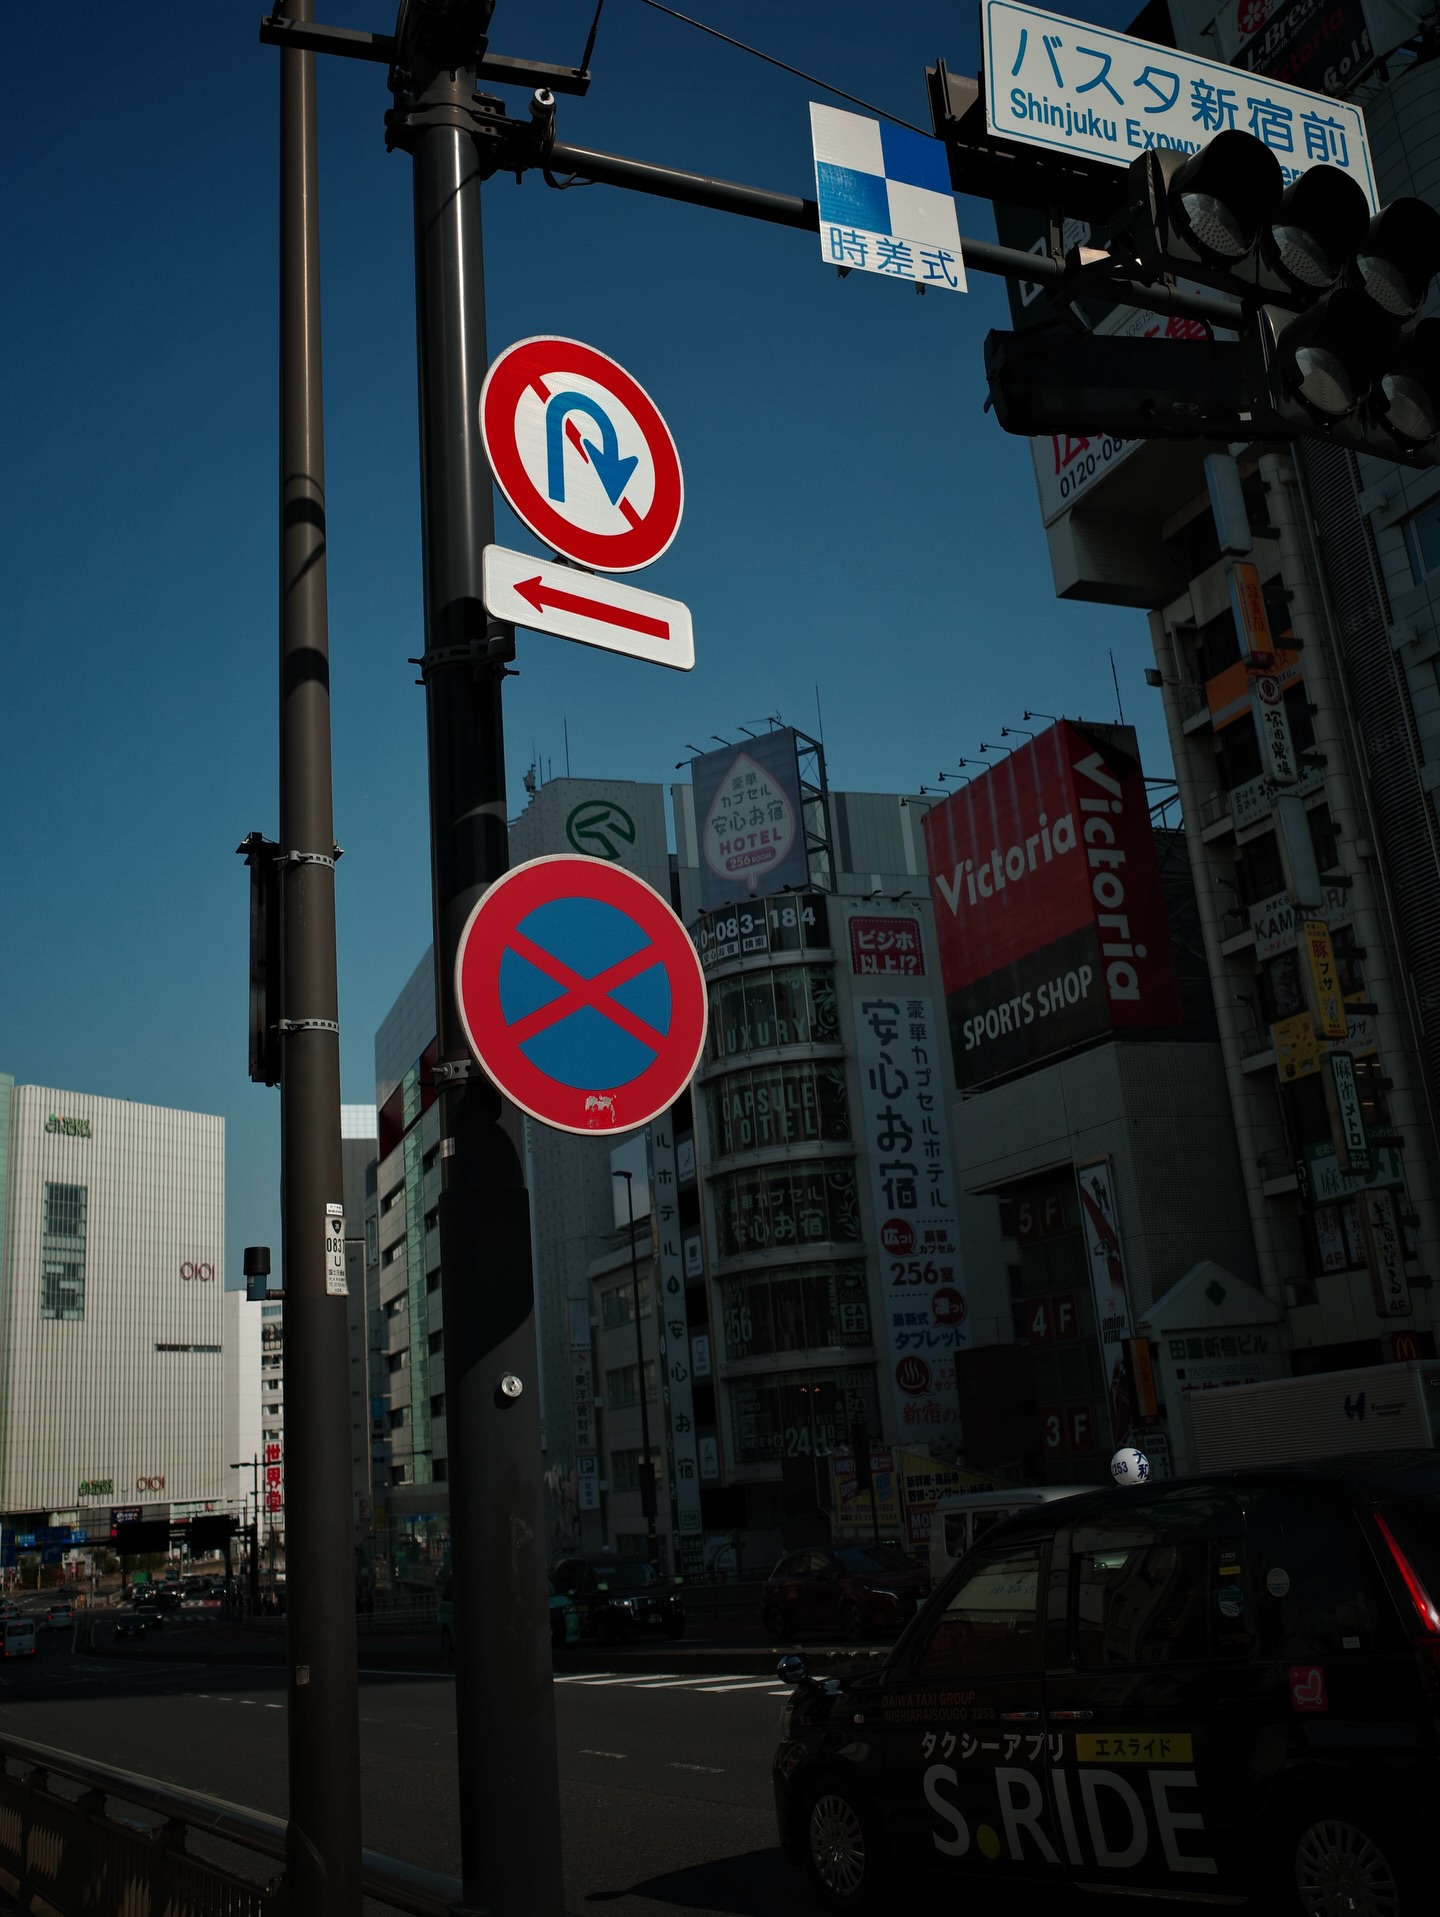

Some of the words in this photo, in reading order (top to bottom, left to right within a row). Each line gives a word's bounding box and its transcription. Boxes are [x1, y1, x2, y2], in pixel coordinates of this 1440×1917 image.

[1011, 29, 1349, 167] バスタ新宿前
[1011, 88, 1117, 142] Shinjuku
[829, 226, 958, 287] 時差式
[720, 784, 772, 808] カプセル
[711, 800, 784, 837] 安心お宿
[719, 827, 782, 856] HOTEL
[730, 858, 751, 869] 256
[751, 854, 772, 863] ROOM
[935, 811, 1077, 918] Victoria
[1072, 751, 1149, 1001] Victoria
[857, 929, 916, 950] ビジホ
[963, 992, 1034, 1051] SPORTS
[1039, 964, 1093, 1018] SHOP
[722, 1083, 815, 1122] CAPSULE
[861, 998, 919, 1211] 安心お宿
[905, 1000, 948, 1208] 豪華カプセルホテル
[1335, 1060, 1363, 1147] 麻雀メトロ
[724, 1111, 818, 1150] HOTEL
[1018, 1196, 1058, 1234] 5F
[894, 1328, 967, 1350] タブレット
[1032, 1303, 1072, 1338] 4F
[1046, 1413, 1087, 1449] 3F
[266, 1443, 281, 1514] 世界堂
[1133, 1450, 1149, 1480] 大和
[882, 1695, 913, 1708] DAIWA
[916, 1693, 939, 1707] TAXI
[939, 1691, 976, 1706] GROUP
[972, 1707, 995, 1720] 2253
[921, 1731, 1065, 1763] タクシーアプリ
[1096, 1738, 1171, 1758] エスライド
[923, 1764, 1219, 1875] S.RIDE
